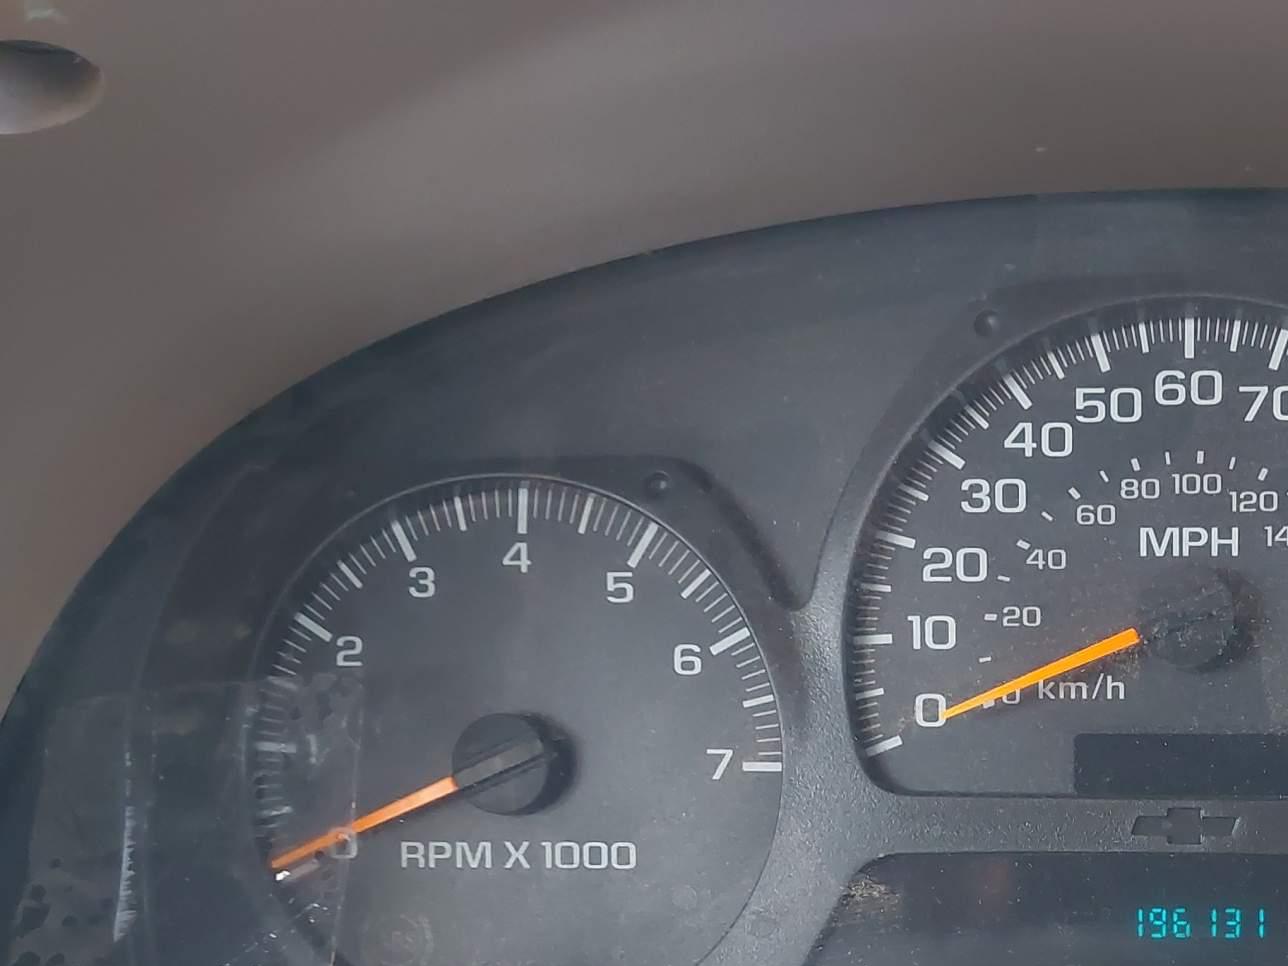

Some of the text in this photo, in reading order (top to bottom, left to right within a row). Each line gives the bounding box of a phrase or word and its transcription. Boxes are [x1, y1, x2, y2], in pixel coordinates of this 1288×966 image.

[1155, 371, 1222, 405] 60
[1076, 388, 1141, 422] 50
[1004, 423, 1072, 456] 40
[961, 479, 1026, 512] 30
[1121, 479, 1159, 498] 80
[1172, 474, 1221, 494] 100
[1077, 505, 1115, 524] 60
[1230, 491, 1277, 512] 120
[1140, 527, 1238, 556] MPH
[503, 543, 531, 573] 4
[923, 548, 987, 581] 20
[1027, 549, 1066, 569] 40
[410, 567, 435, 597] 3
[607, 572, 633, 602] 5
[1003, 607, 1040, 626] 20
[908, 616, 956, 649] 10
[337, 637, 362, 666] 2
[674, 645, 701, 674] 6
[1039, 674, 1124, 699] km/h
[915, 694, 946, 727] 0
[707, 749, 732, 779] 7
[402, 842, 636, 869] RPM X 1000
[1138, 909, 1264, 938] 196131
